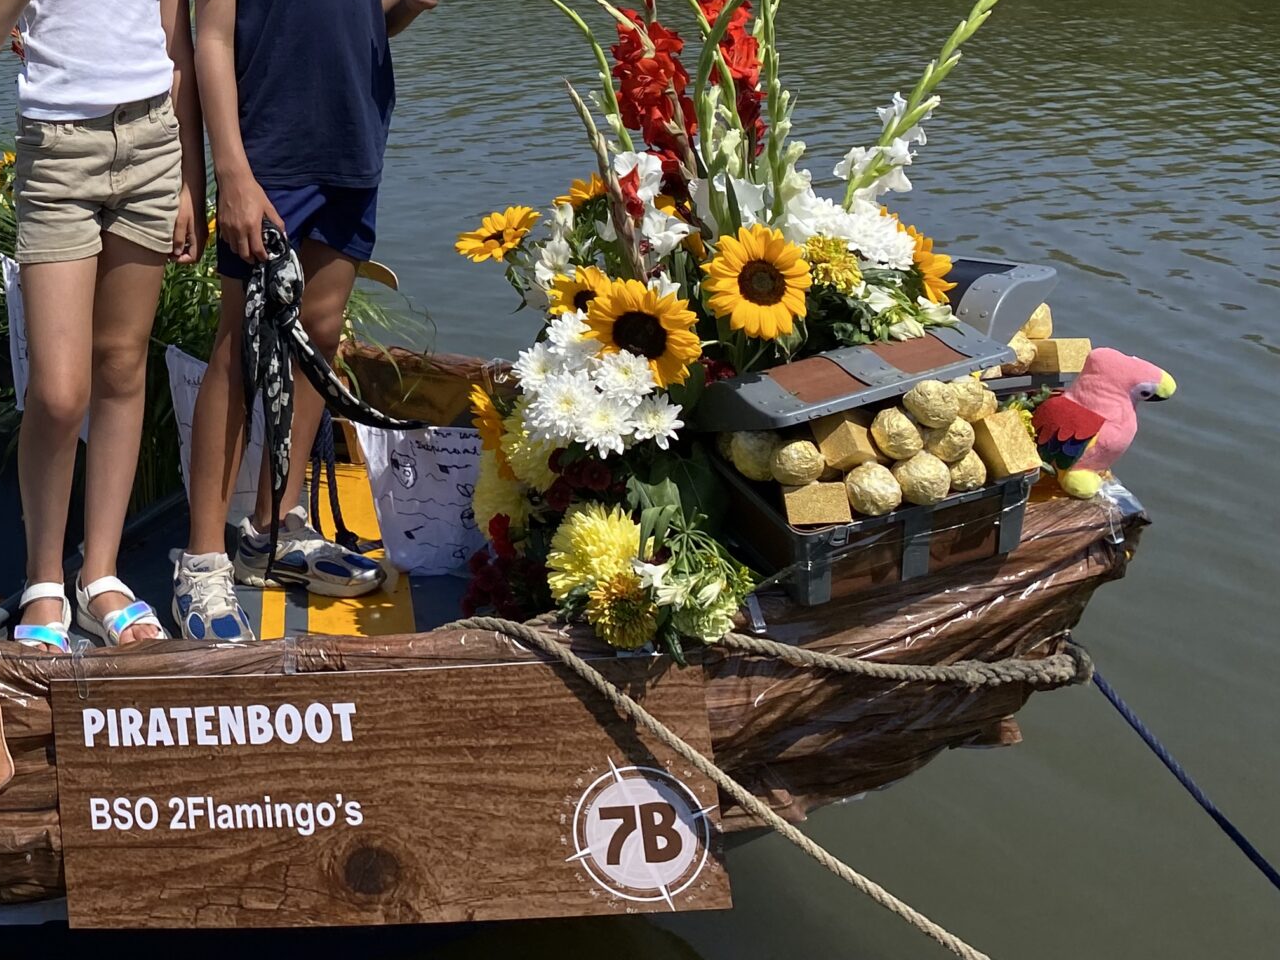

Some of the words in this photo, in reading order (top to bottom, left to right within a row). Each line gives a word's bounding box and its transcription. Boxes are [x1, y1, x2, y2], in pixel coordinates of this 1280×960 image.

[82, 702, 356, 747] PIRATENBOOT
[89, 796, 159, 831] BSO
[168, 793, 364, 836] 2Flamingo's
[598, 801, 683, 866] 7B
